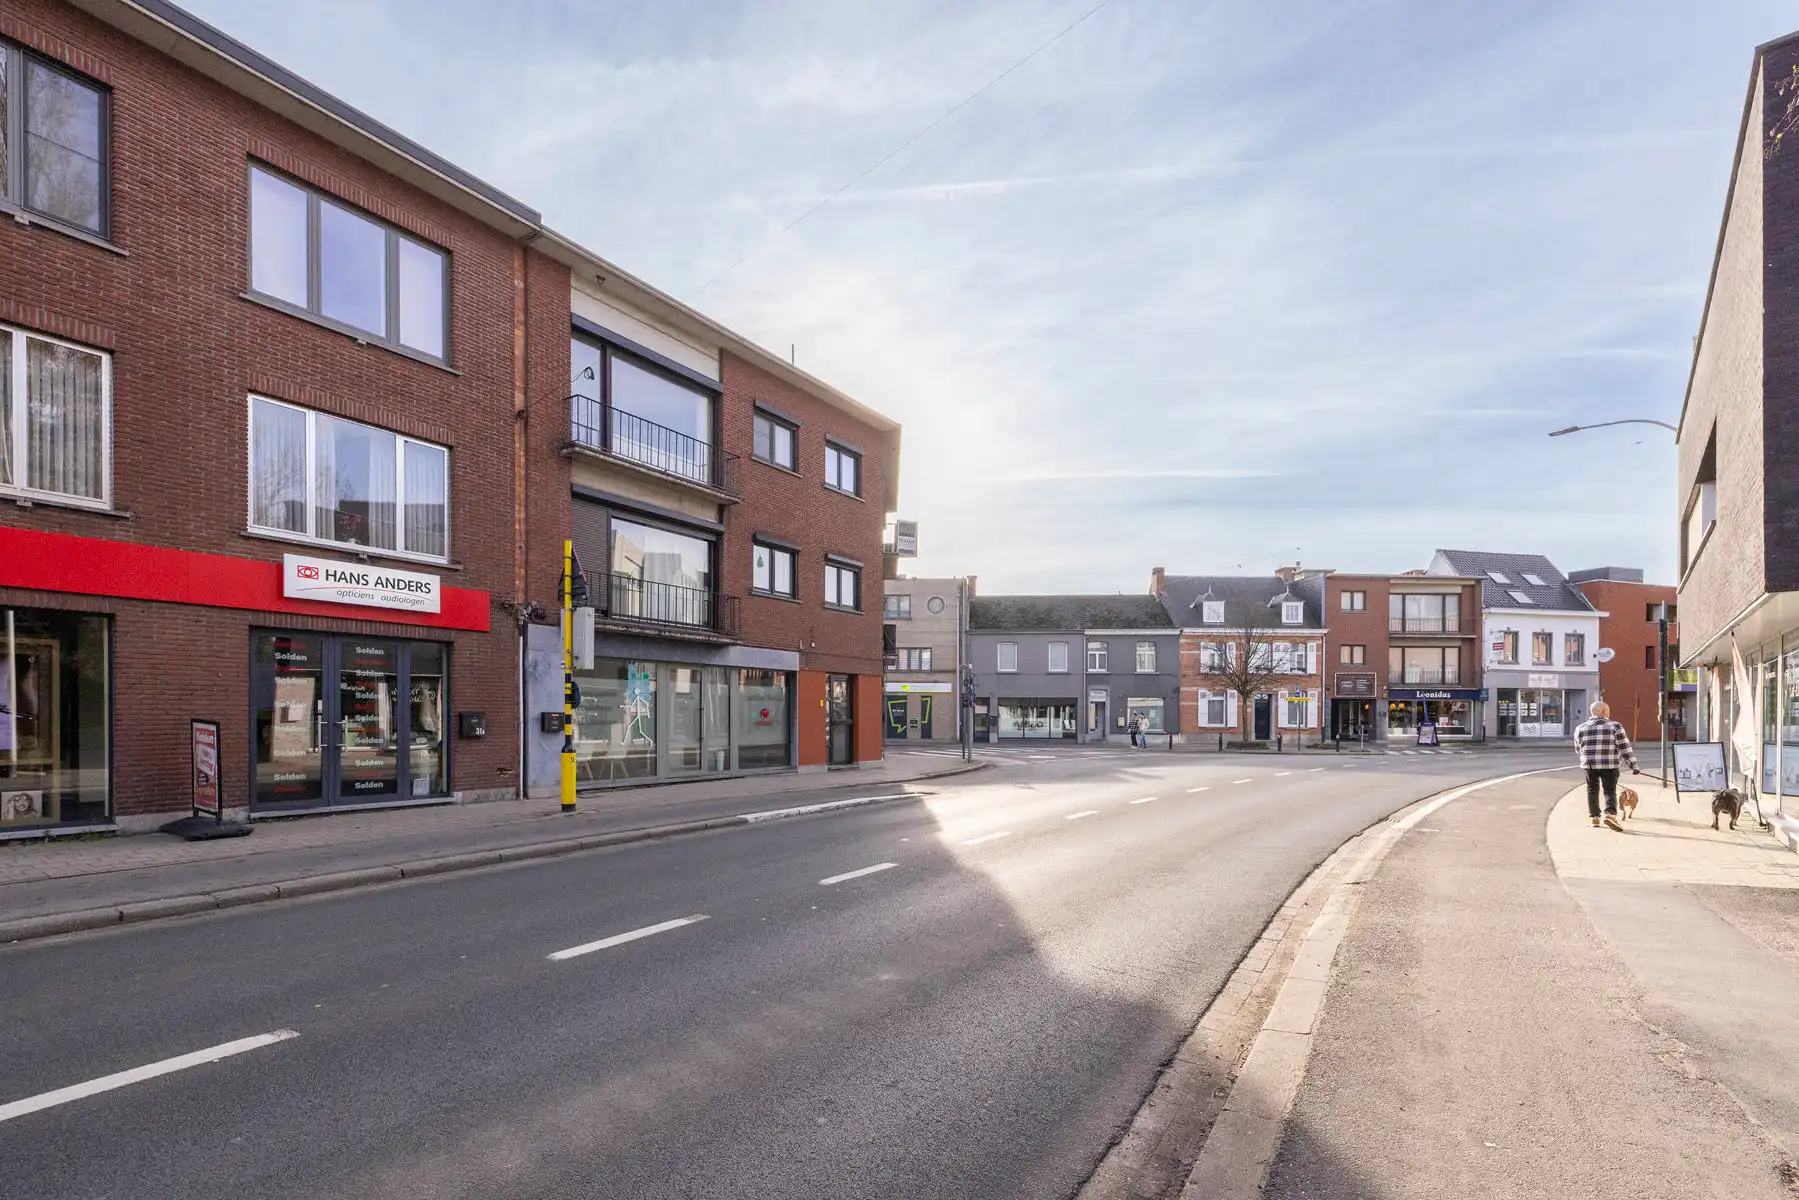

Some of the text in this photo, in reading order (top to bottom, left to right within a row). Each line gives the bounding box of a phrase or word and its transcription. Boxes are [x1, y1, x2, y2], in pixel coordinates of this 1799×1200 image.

[325, 569, 431, 594] HANS ANDERS
[336, 589, 425, 606] opticiens audiologen
[355, 646, 384, 655] Solden
[274, 652, 307, 661] Solden
[355, 669, 384, 677] Solden
[355, 736, 384, 744] Solden
[355, 759, 384, 767] Solden
[273, 773, 306, 781] Solden
[355, 781, 384, 789] Solden
